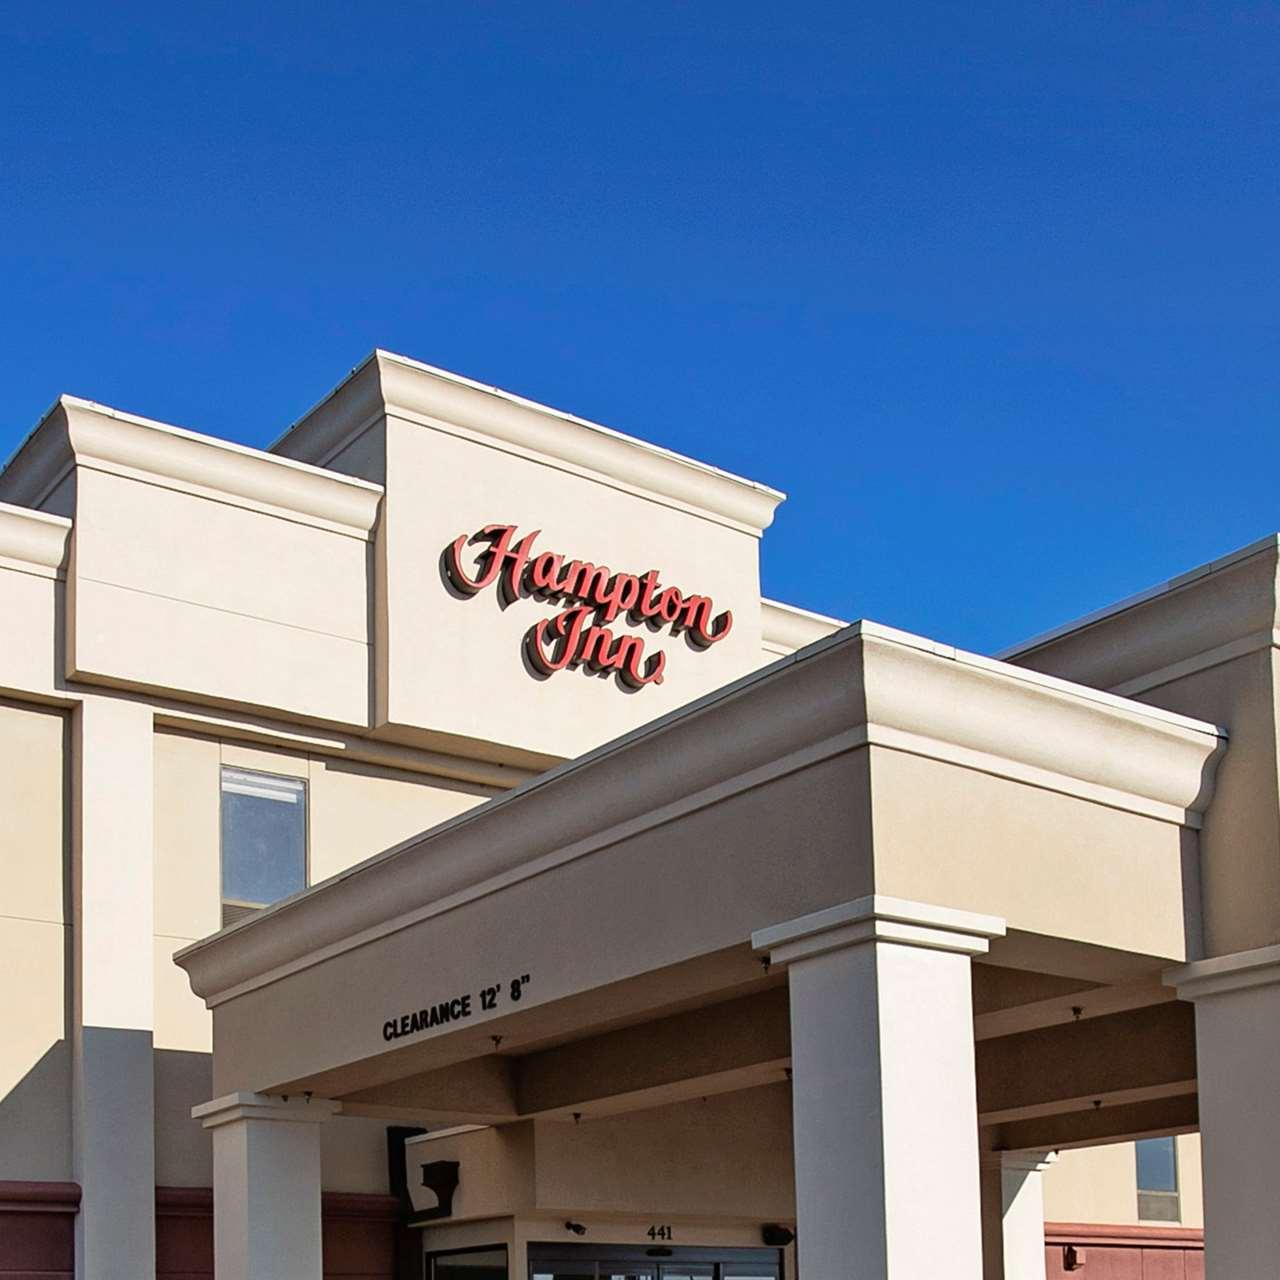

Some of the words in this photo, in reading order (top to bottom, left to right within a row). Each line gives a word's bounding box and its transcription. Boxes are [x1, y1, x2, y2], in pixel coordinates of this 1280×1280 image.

[442, 524, 733, 646] Hampton
[526, 606, 666, 688] Inn
[383, 994, 472, 1041] CLEARANCE
[479, 983, 501, 1011] 12'
[647, 1225, 672, 1240] 441
